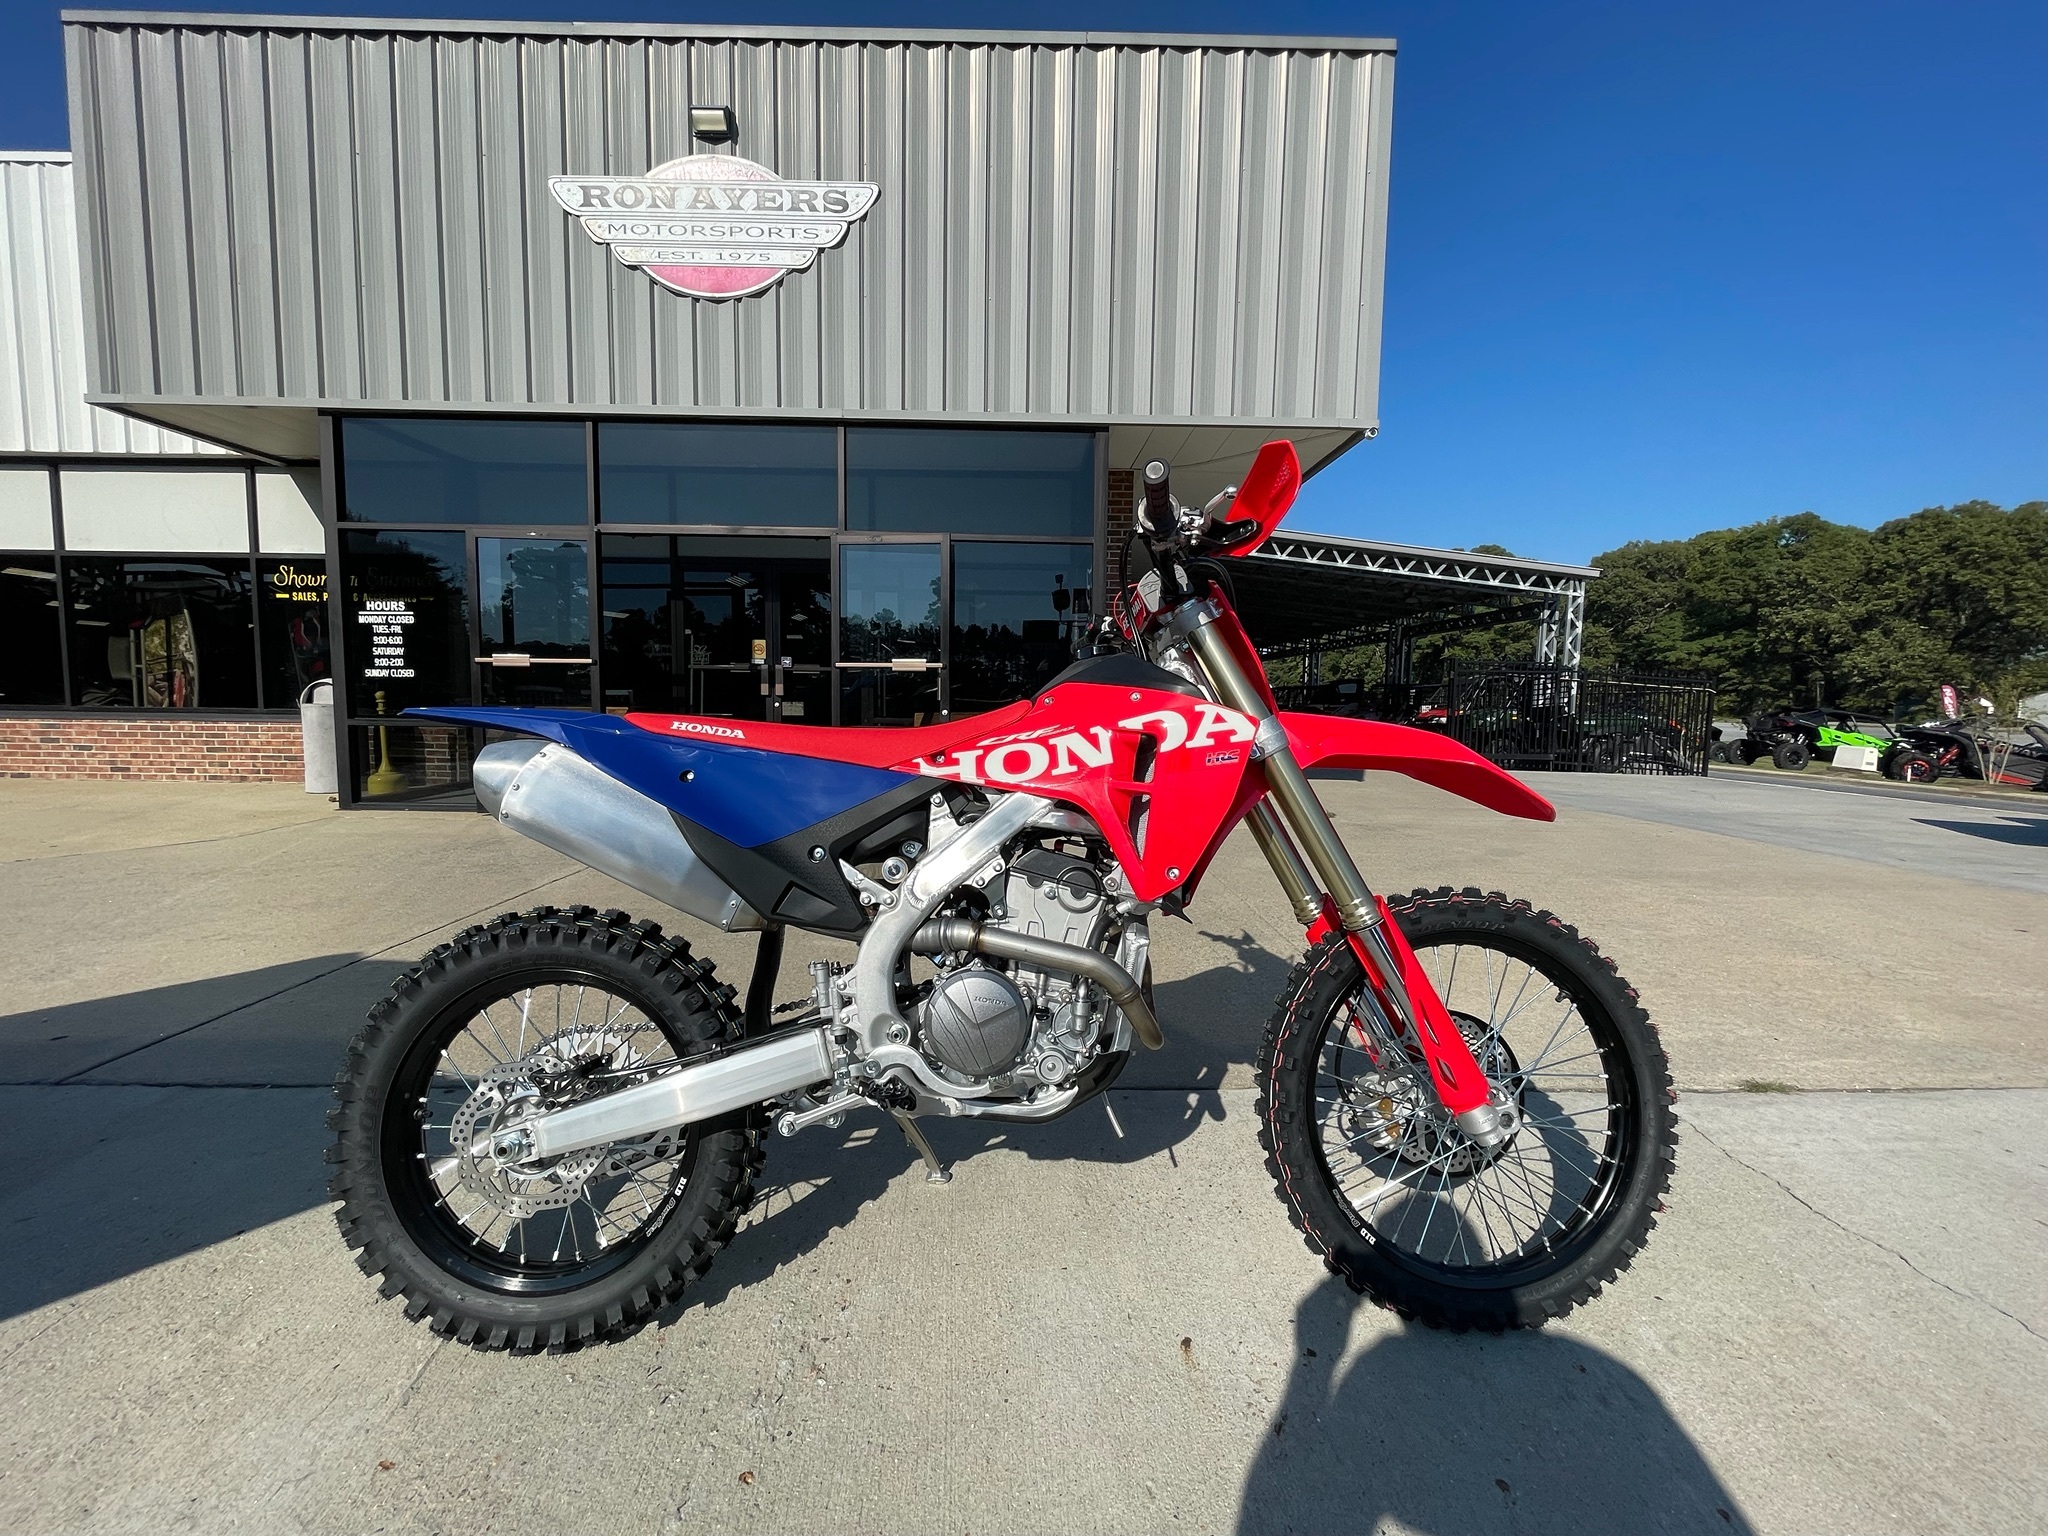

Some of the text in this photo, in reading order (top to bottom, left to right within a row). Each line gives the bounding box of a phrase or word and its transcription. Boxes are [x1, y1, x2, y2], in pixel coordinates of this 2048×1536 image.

[578, 184, 850, 214] RON AYERS
[607, 223, 819, 239] MOTORSPORTS
[657, 251, 771, 262] EST. 1975
[292, 591, 320, 602] SALES,
[366, 600, 406, 611] HOURS
[358, 615, 415, 624] MONDAY CLOSED
[372, 647, 405, 655] SATURDAY
[374, 658, 404, 667] 9:00-2:00
[365, 669, 415, 677] SUNDAY CLOSED
[670, 721, 746, 739] HONDA
[913, 704, 1257, 785] HONDA
[974, 995, 1008, 1006] HONDA
